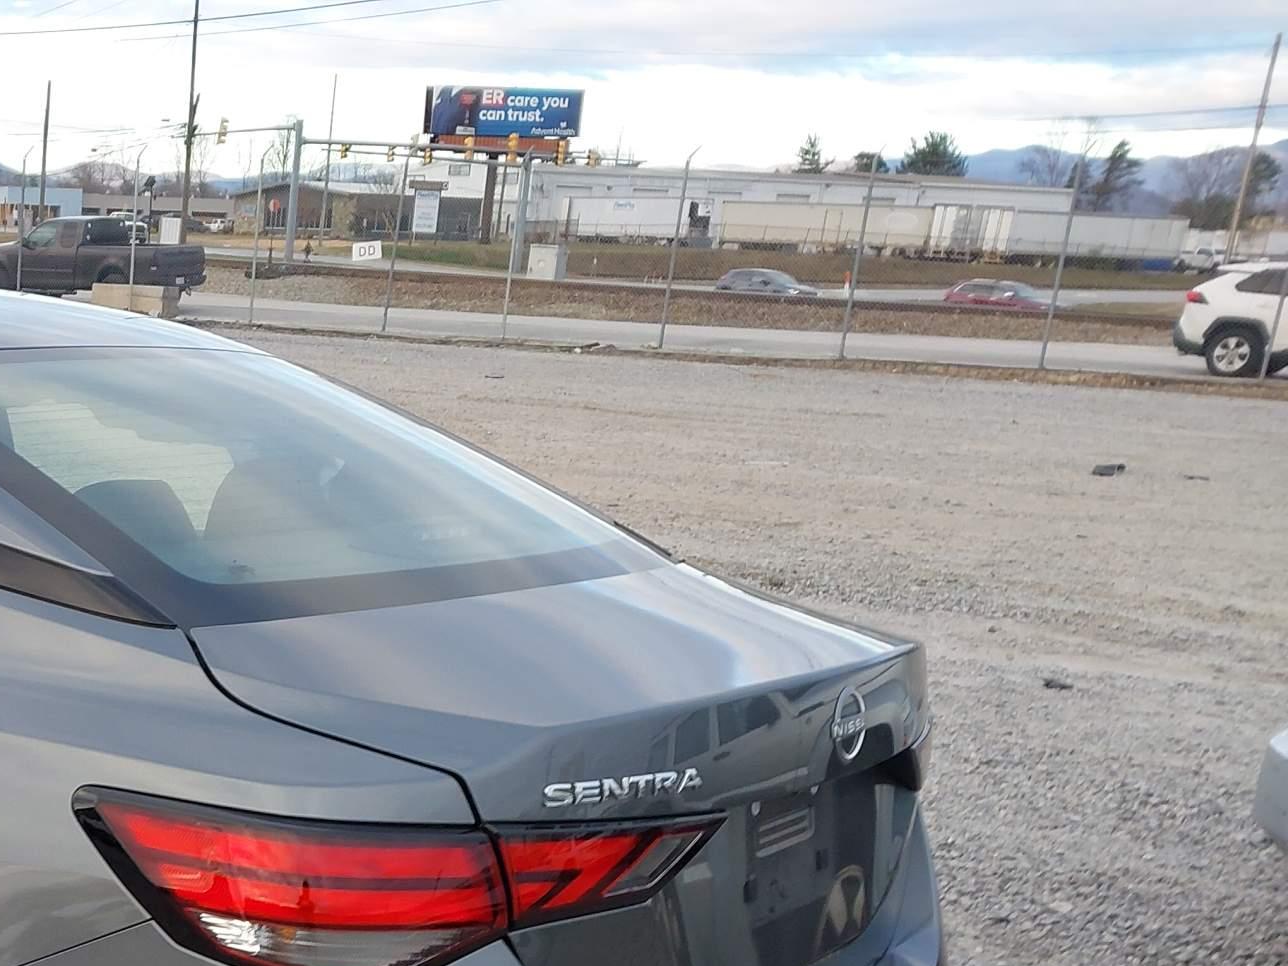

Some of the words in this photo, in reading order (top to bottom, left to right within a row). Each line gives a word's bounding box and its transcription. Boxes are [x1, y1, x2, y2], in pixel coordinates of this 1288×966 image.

[482, 88, 504, 105] ER
[507, 95, 538, 107] care
[542, 96, 569, 110] you
[479, 110, 504, 121] can
[507, 109, 544, 122] trust.
[833, 718, 865, 738] NISS
[543, 767, 703, 808] SENTRA
